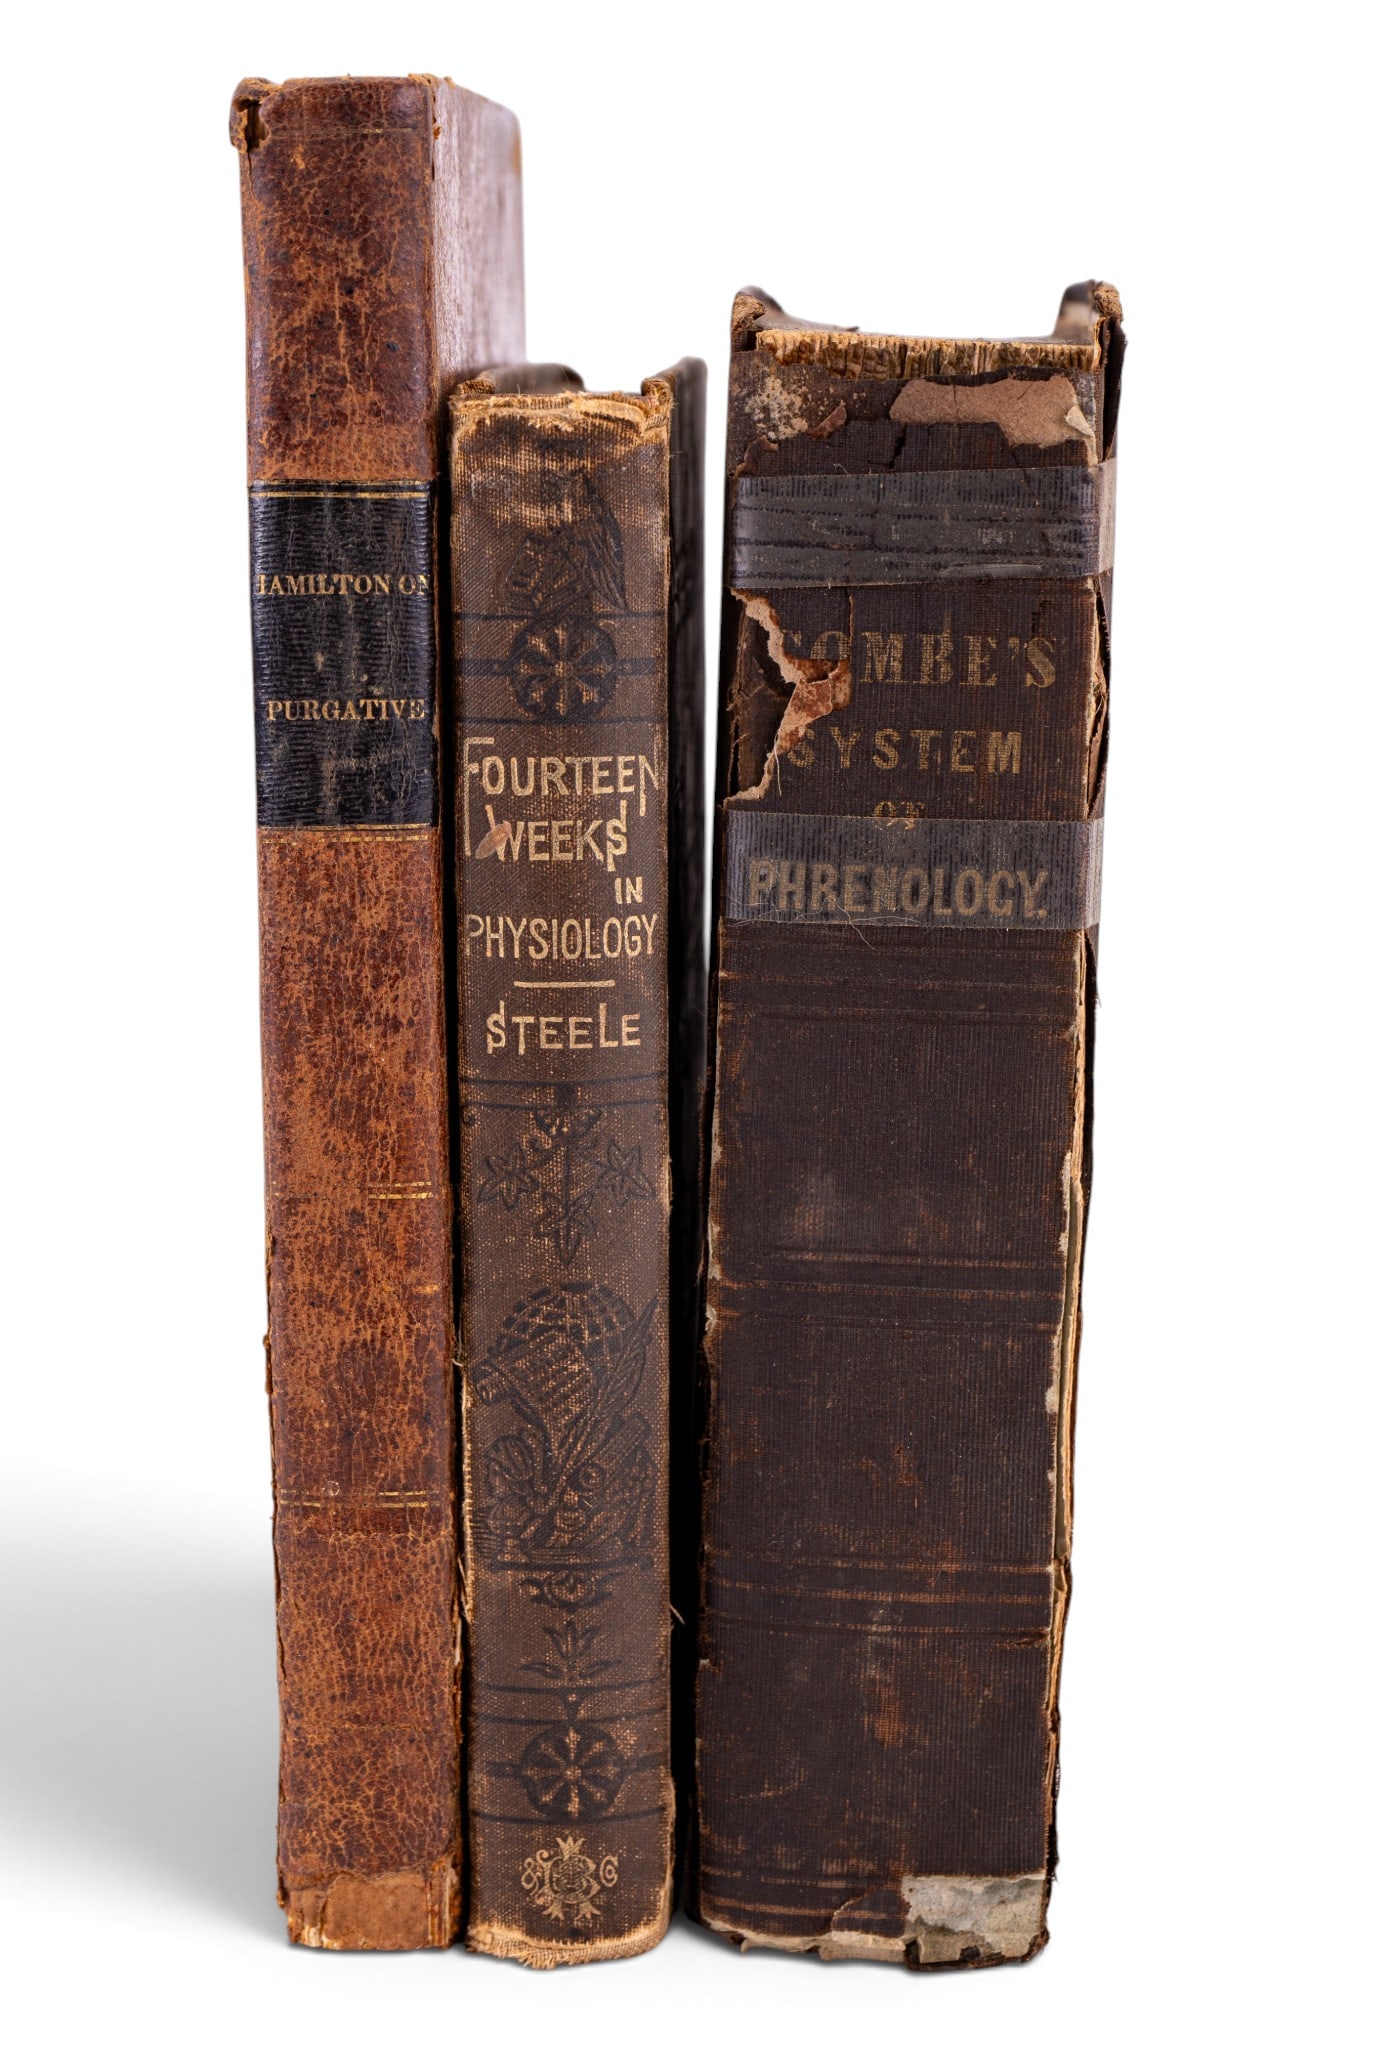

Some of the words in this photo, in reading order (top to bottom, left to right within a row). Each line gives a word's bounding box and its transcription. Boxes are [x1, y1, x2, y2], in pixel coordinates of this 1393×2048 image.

[781, 630, 1057, 688] OMBE'S
[267, 699, 425, 721] PURGATIVE
[786, 728, 1021, 774] SYSTEM
[463, 737, 659, 856] FOURTEEN
[485, 800, 628, 872] WEEKS
[615, 877, 643, 904] IN
[466, 914, 658, 960] PHYSIOLOGY
[486, 1000, 641, 1056] STEELE
